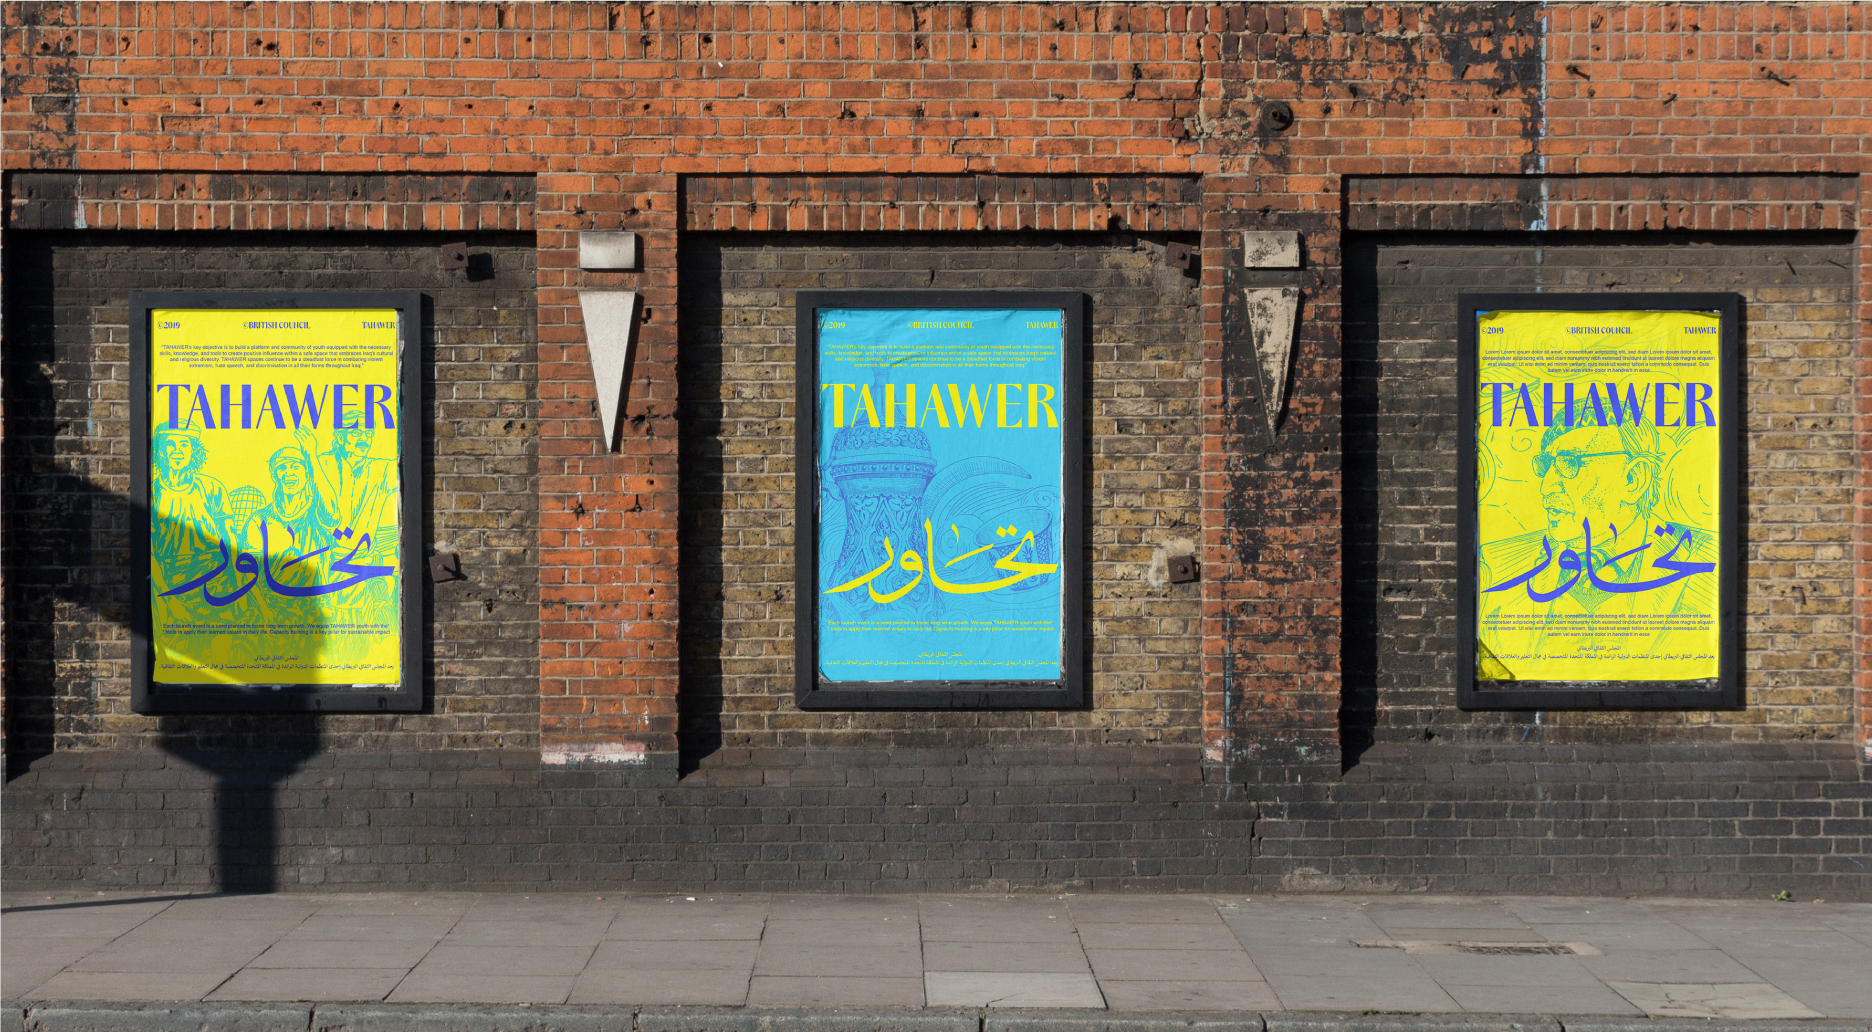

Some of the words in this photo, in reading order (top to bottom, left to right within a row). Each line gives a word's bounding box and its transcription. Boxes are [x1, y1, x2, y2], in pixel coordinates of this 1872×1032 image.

[157, 384, 395, 429] TAHAWER
[822, 384, 1058, 428] TAHAWER
[1481, 383, 1716, 427] TAHAWER
